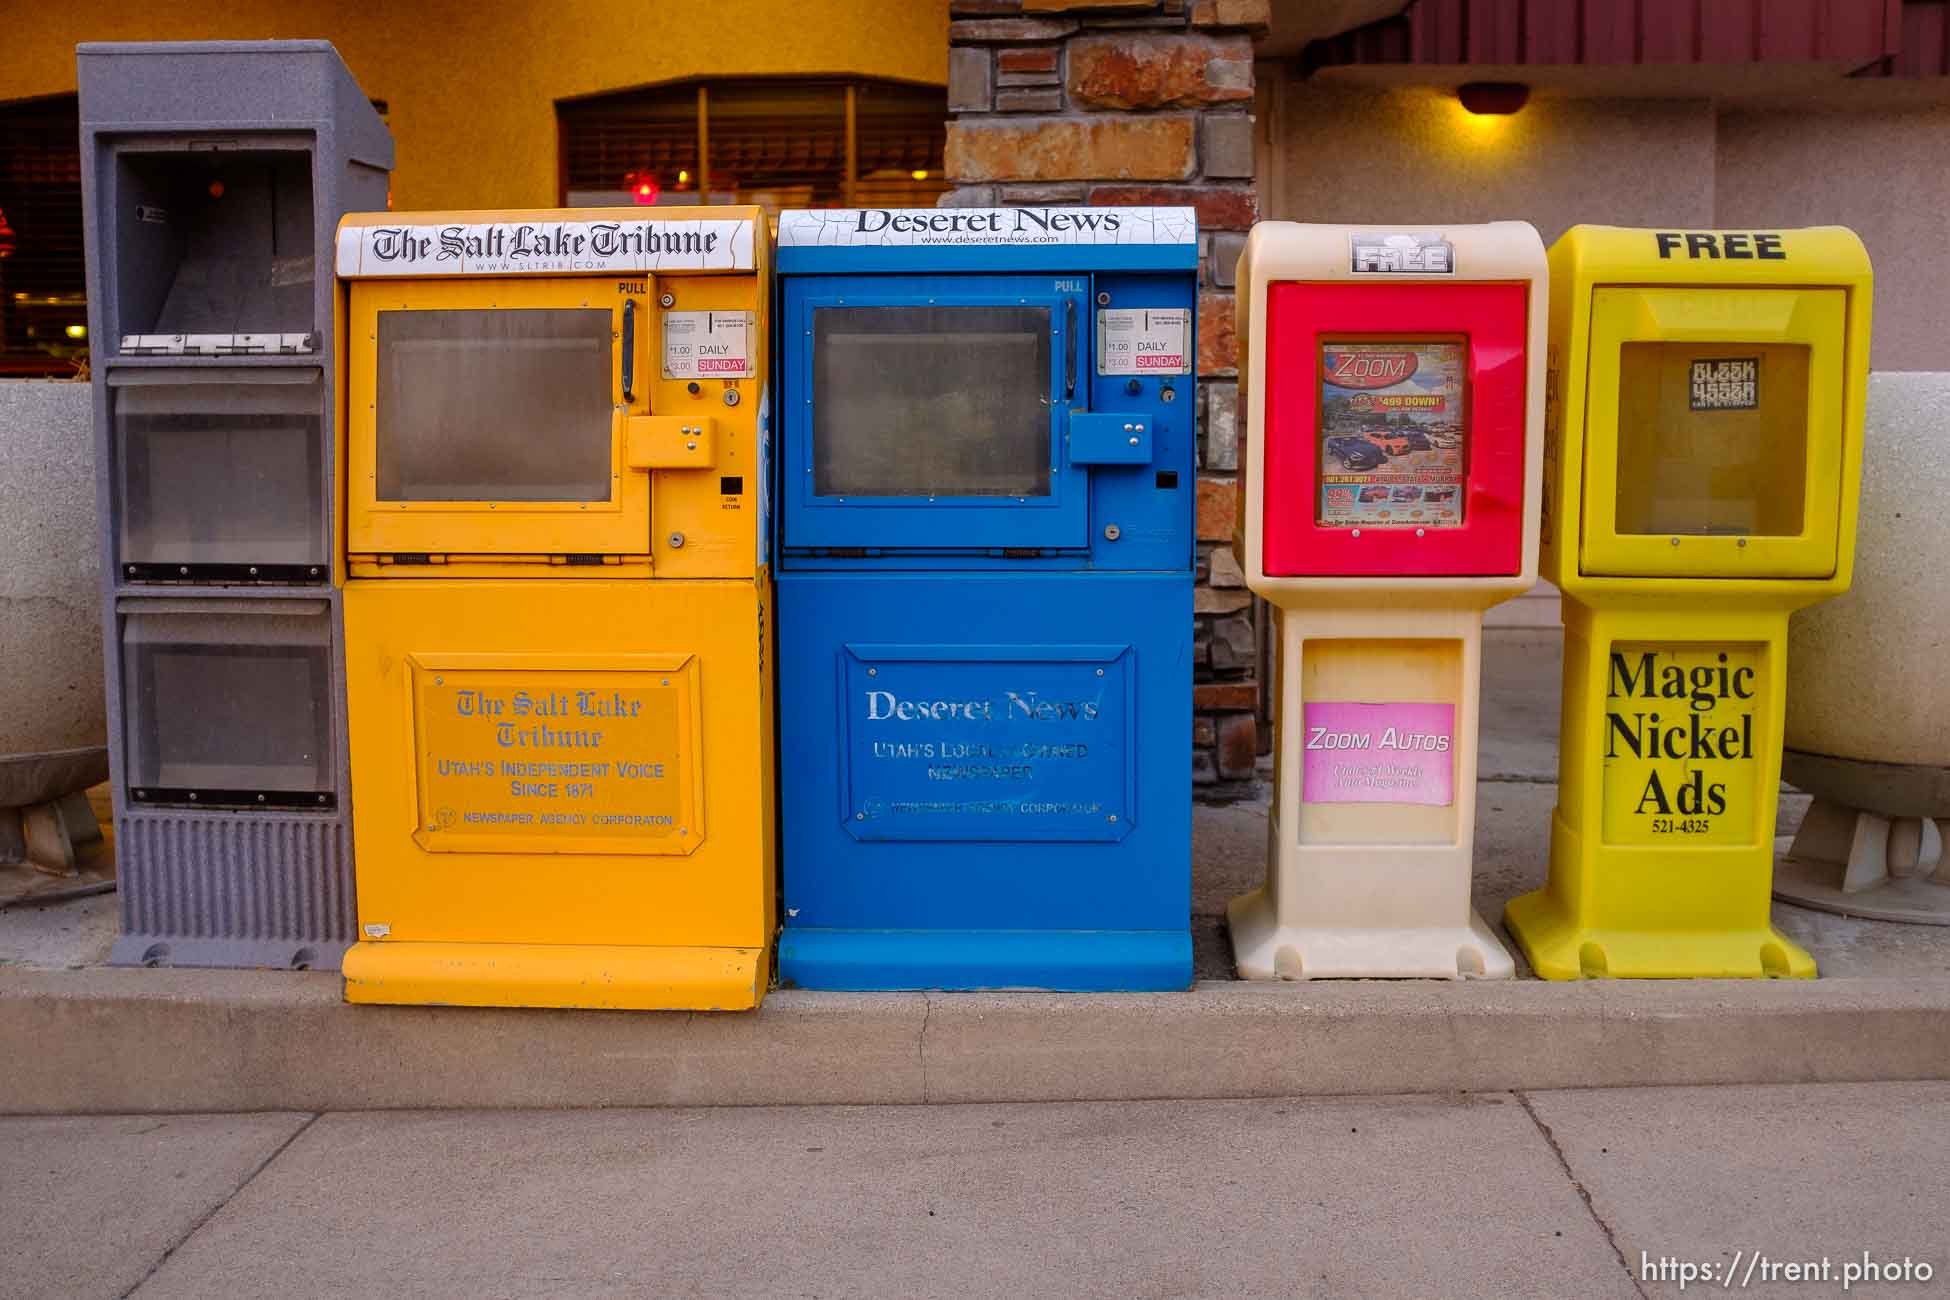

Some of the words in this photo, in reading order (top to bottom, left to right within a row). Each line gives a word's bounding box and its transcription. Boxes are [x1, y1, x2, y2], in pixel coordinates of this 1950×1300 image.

[854, 209, 1000, 233] Deseret
[1014, 208, 1121, 232] News
[373, 228, 432, 263] The
[436, 225, 505, 261] Salt
[509, 225, 585, 260] Lake
[590, 223, 719, 258] Tribune
[920, 234, 1059, 244] www.deseretnews.com
[1655, 233, 1786, 259] FREE
[619, 283, 646, 294] PULL
[1055, 280, 1083, 292] PULL
[699, 345, 729, 355] DAILY
[1137, 342, 1166, 351] DAILY
[699, 360, 745, 370] SUNDAY
[1137, 356, 1182, 367] SUNDAY
[1607, 652, 1755, 711] Magic
[456, 690, 504, 717] The
[512, 691, 568, 716] Salt
[576, 690, 641, 717] Lake
[865, 690, 991, 720] Deseret
[1004, 690, 1099, 720] News
[496, 722, 604, 748] Tribune
[1605, 712, 1753, 759] Nickel
[565, 783, 593, 798] 1871
[1633, 768, 1726, 816] Ads
[463, 812, 534, 825] NEWSPAPER
[540, 813, 587, 825] AGENCY
[1652, 819, 1709, 833] 521-4325
